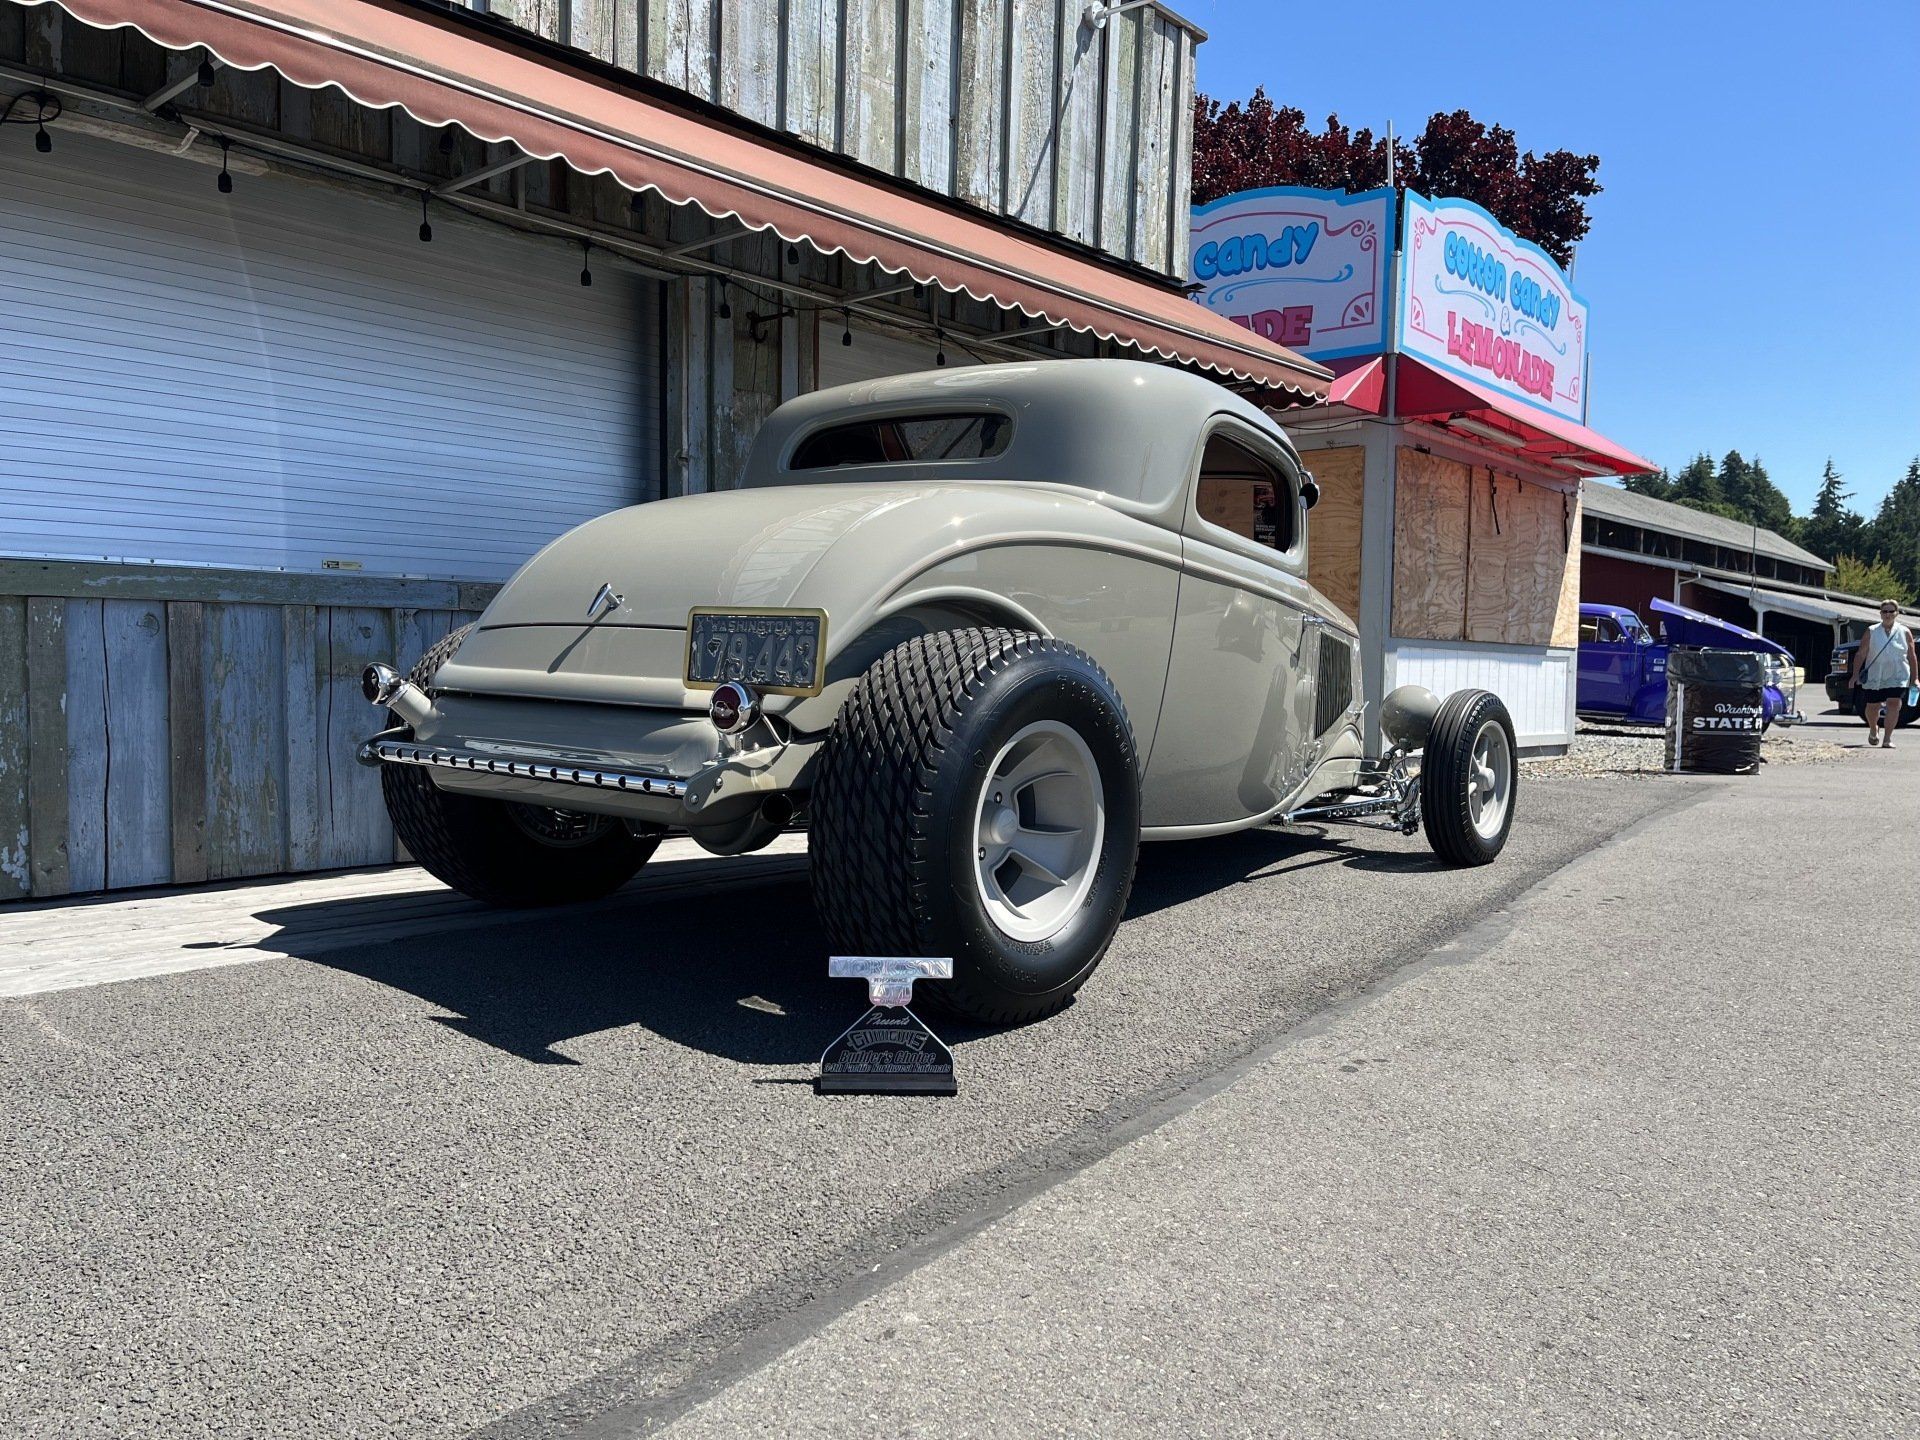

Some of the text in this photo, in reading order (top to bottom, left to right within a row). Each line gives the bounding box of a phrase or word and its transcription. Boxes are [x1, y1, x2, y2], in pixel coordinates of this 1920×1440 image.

[1447, 310, 1555, 402] LEMONADE
[1692, 717, 1753, 729] STATE
[866, 1012, 910, 1025] Presents
[839, 1050, 936, 1064] Builder's Choice
